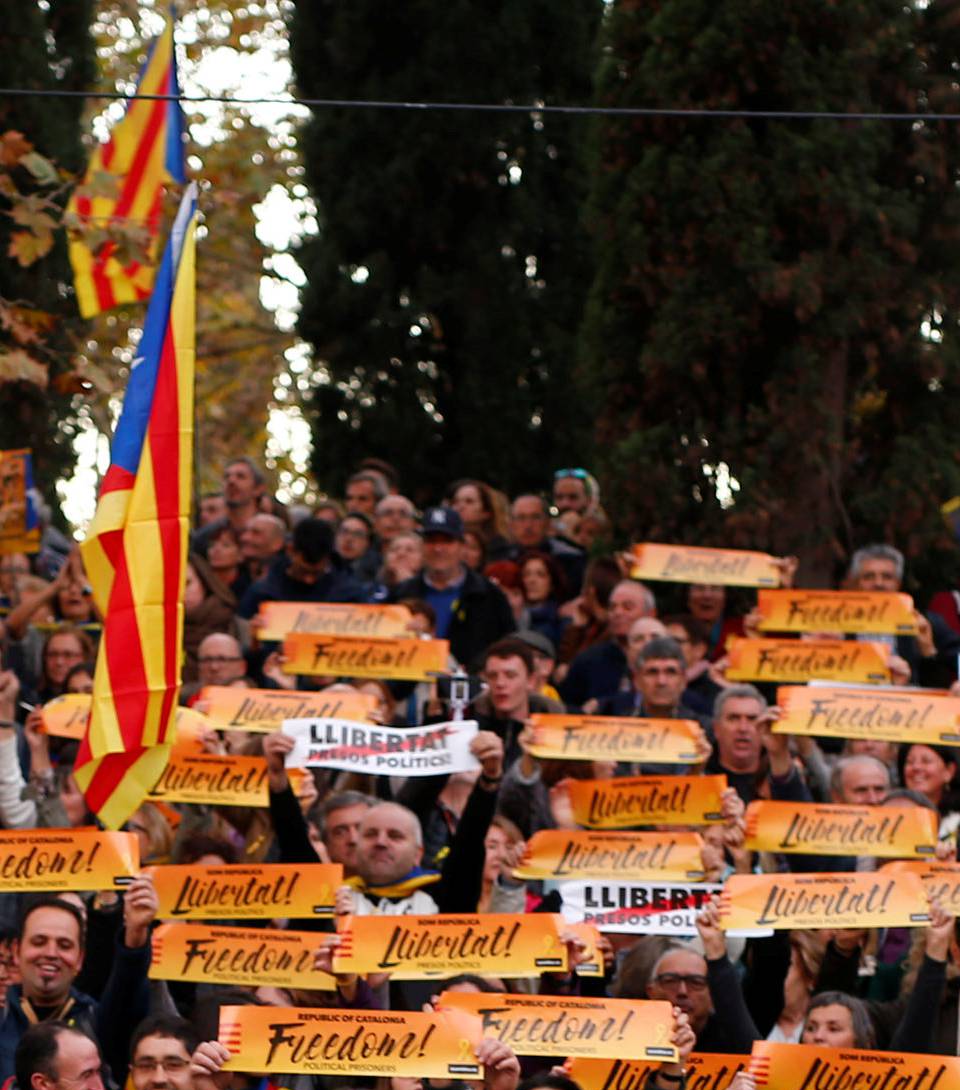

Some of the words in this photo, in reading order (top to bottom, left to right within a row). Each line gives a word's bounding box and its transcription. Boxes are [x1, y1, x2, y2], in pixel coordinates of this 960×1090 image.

[787, 600, 890, 625] Freedom!
[312, 642, 419, 670] Freedom!
[757, 649, 860, 675] Freedom!
[808, 699, 931, 731] Freedom!
[310, 724, 450, 753] LLIBERTAT
[563, 726, 670, 753] Freedom!
[308, 750, 369, 766] PRESOS
[589, 784, 691, 824] Llibertat!
[779, 813, 903, 848] Llibertat!
[553, 840, 676, 875] Llibertat!
[170, 872, 300, 914] Llibertat!
[584, 886, 724, 910] LLIBERT
[756, 880, 896, 926] Llibertat!
[583, 911, 651, 927] PRESOS
[182, 938, 320, 977] Freedom
[378, 922, 521, 968] Llibertat!
[298, 1013, 340, 1022] REPUBLIC
[356, 1016, 406, 1024] CATALONIA
[265, 1022, 437, 1066] Freedom!
[303, 1062, 347, 1070] POLITICAL
[349, 1064, 396, 1072] PRISONERS
